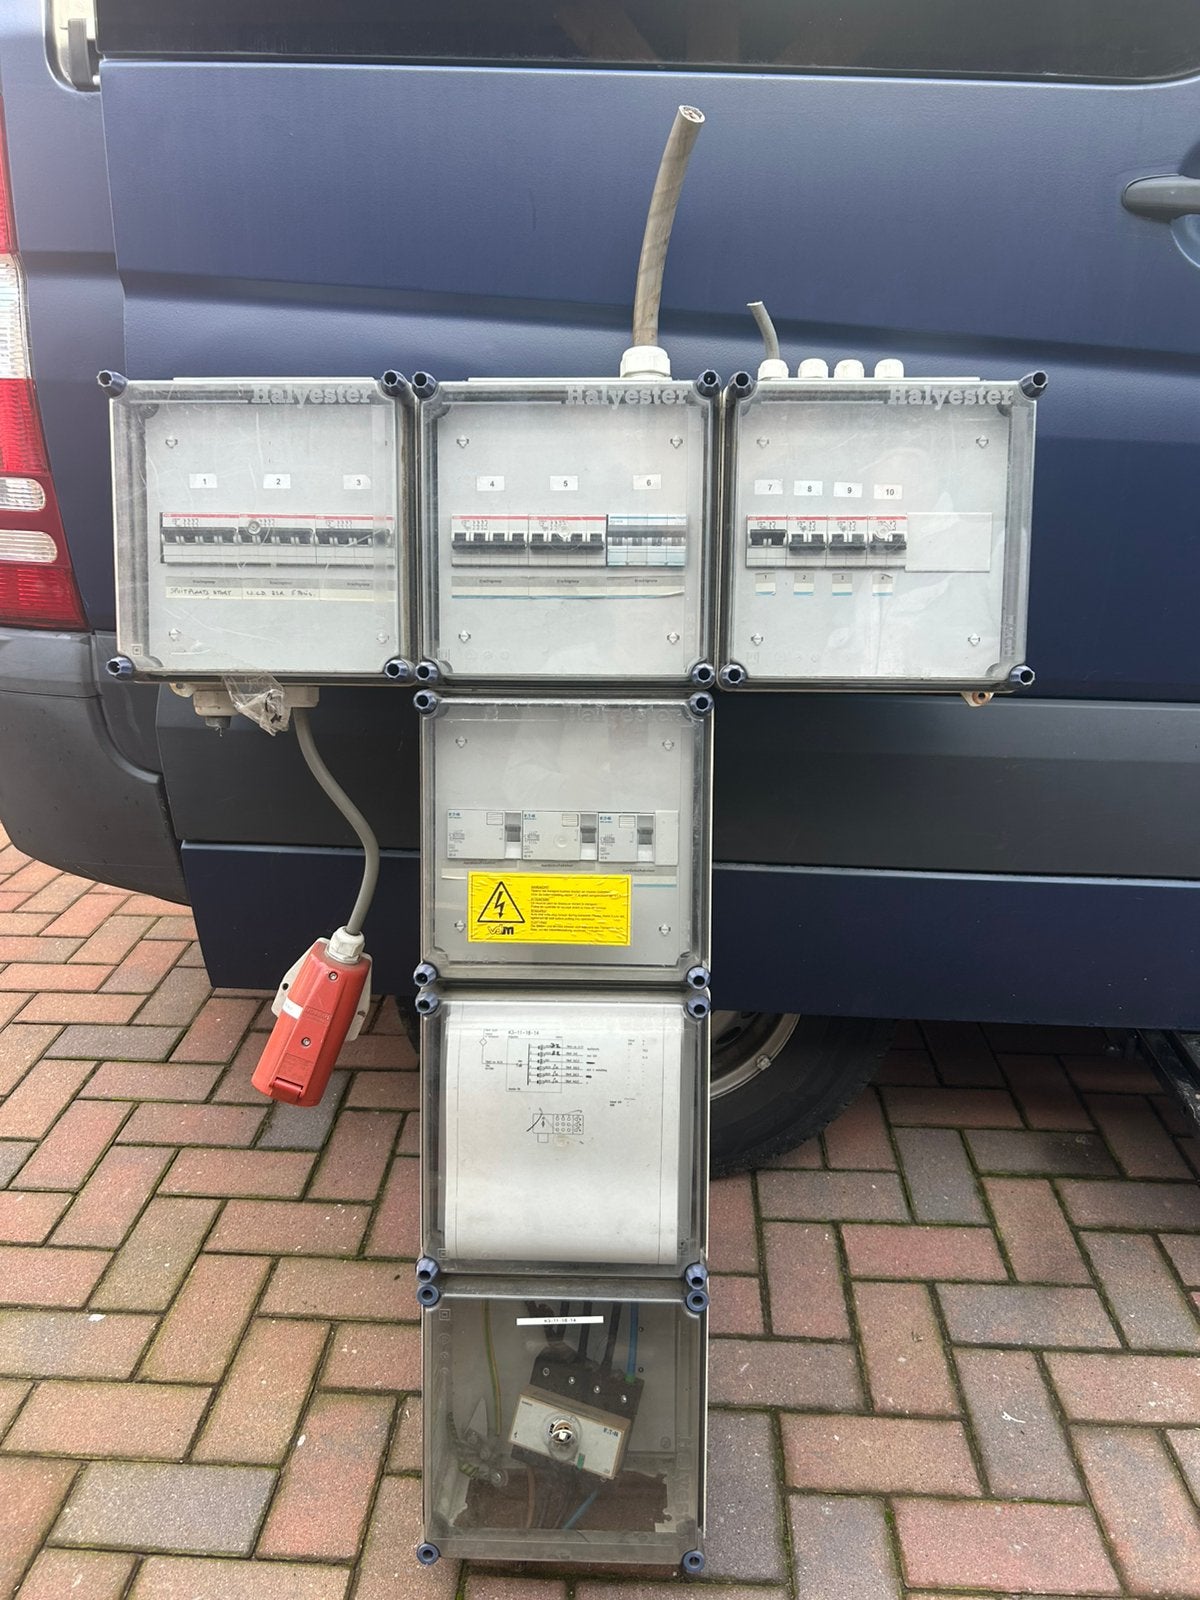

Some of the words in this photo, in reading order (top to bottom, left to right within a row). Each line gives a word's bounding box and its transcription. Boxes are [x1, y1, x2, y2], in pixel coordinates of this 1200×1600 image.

[250, 385, 371, 408] Halyester
[565, 386, 689, 409] Halyester
[888, 386, 1013, 409] Halyester
